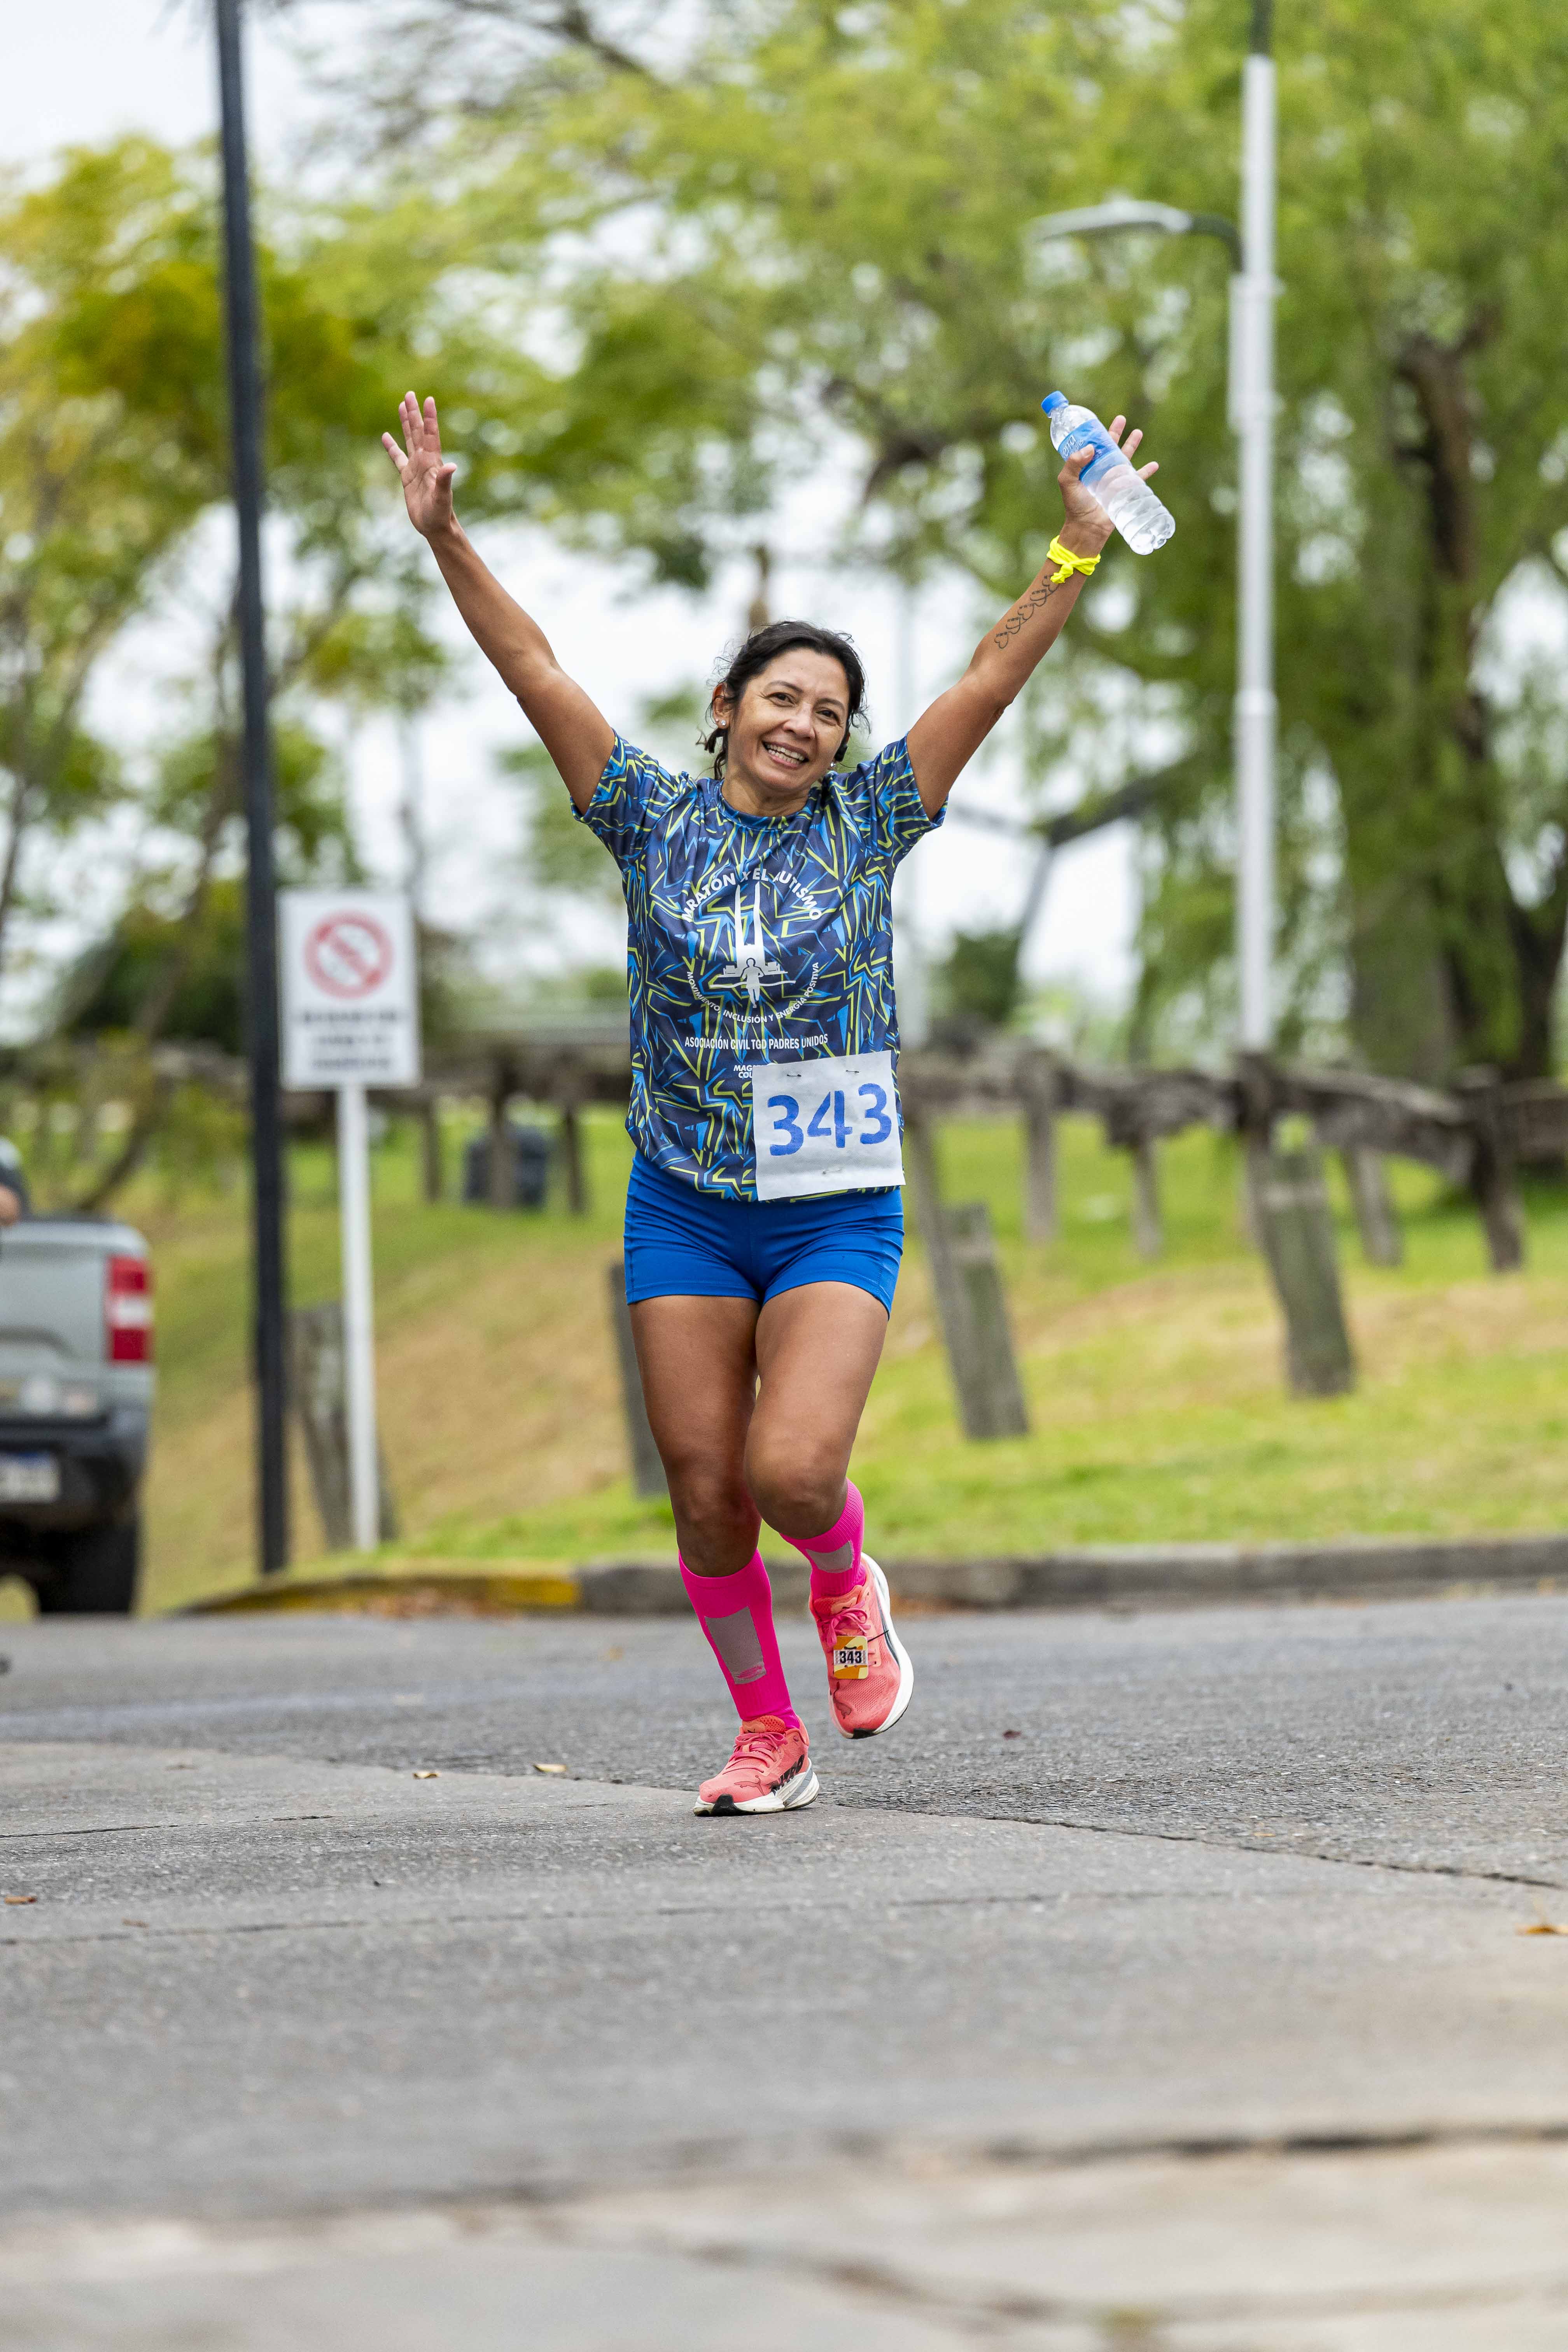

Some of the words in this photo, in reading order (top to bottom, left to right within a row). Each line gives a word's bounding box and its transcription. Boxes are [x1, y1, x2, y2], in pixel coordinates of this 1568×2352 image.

[682, 873, 736, 922] MRATÓN
[753, 868, 768, 881] EL
[772, 870, 822, 920] AUTISMO
[687, 971, 721, 1013] MOVIMIENTO,
[723, 1010, 767, 1023] INCLUSIÓN
[776, 998, 807, 1019] ENERGÍA
[804, 962, 819, 997] POSITIVA
[685, 1036, 728, 1049] ASOCIACIÓN
[730, 1039, 750, 1050] CIVIL
[751, 1039, 767, 1050] TGD
[769, 1038, 799, 1049] PADRES
[802, 1034, 828, 1048] UNIDOS
[766, 1083, 892, 1156] 343
[840, 1651, 862, 1663] 343
